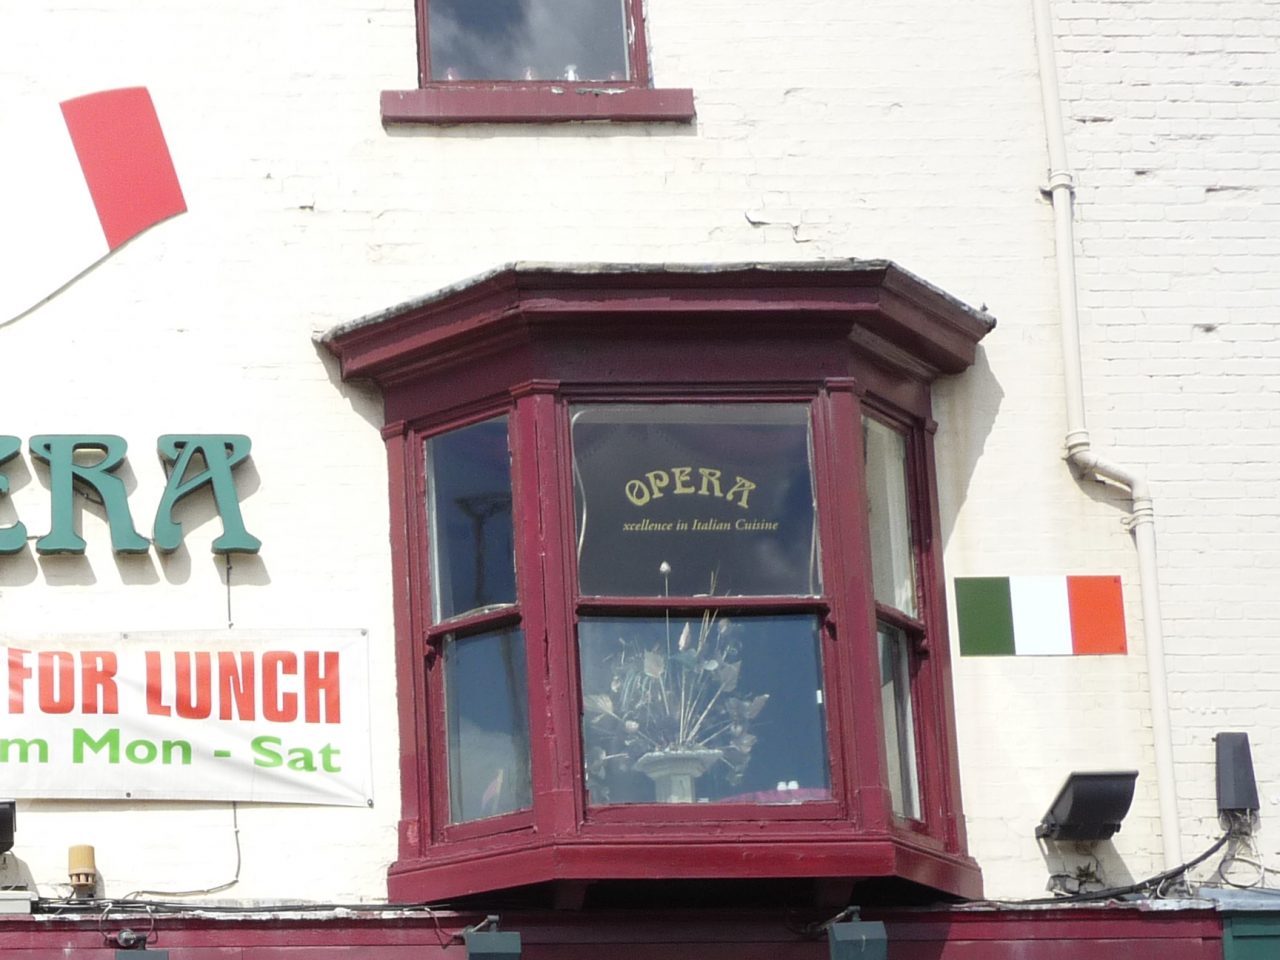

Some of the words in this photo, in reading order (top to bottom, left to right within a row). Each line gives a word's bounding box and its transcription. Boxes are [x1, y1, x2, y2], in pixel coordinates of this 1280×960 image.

[625, 467, 757, 509] OPERA
[623, 519, 673, 531] xcellence
[676, 519, 688, 531] in
[691, 519, 731, 531] Italian
[735, 518, 779, 531] Cuisine
[7, 647, 119, 716] FOR
[145, 650, 341, 724] LUNCH
[72, 727, 192, 765] Mon
[251, 734, 342, 773] Sat
